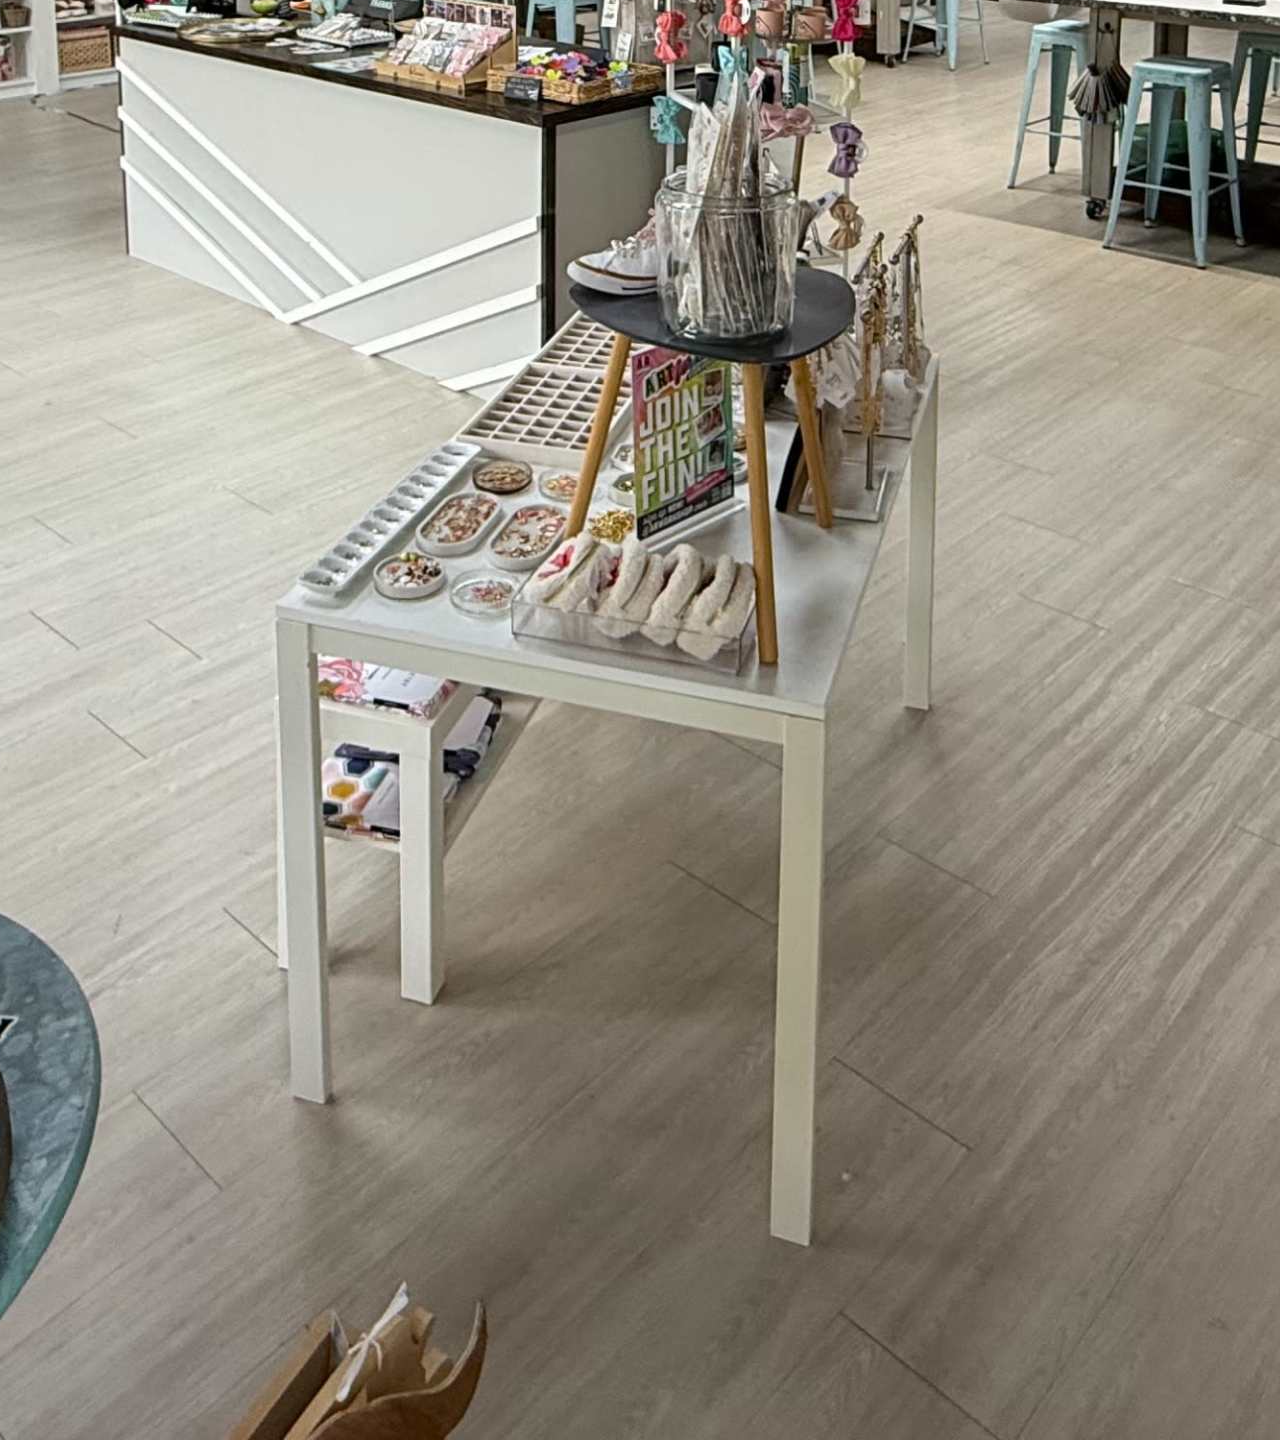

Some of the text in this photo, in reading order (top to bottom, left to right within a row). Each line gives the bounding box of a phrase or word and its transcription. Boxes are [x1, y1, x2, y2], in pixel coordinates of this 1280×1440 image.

[639, 385, 700, 438] JOIN
[639, 423, 691, 474] THE
[641, 447, 704, 511] FUN!
